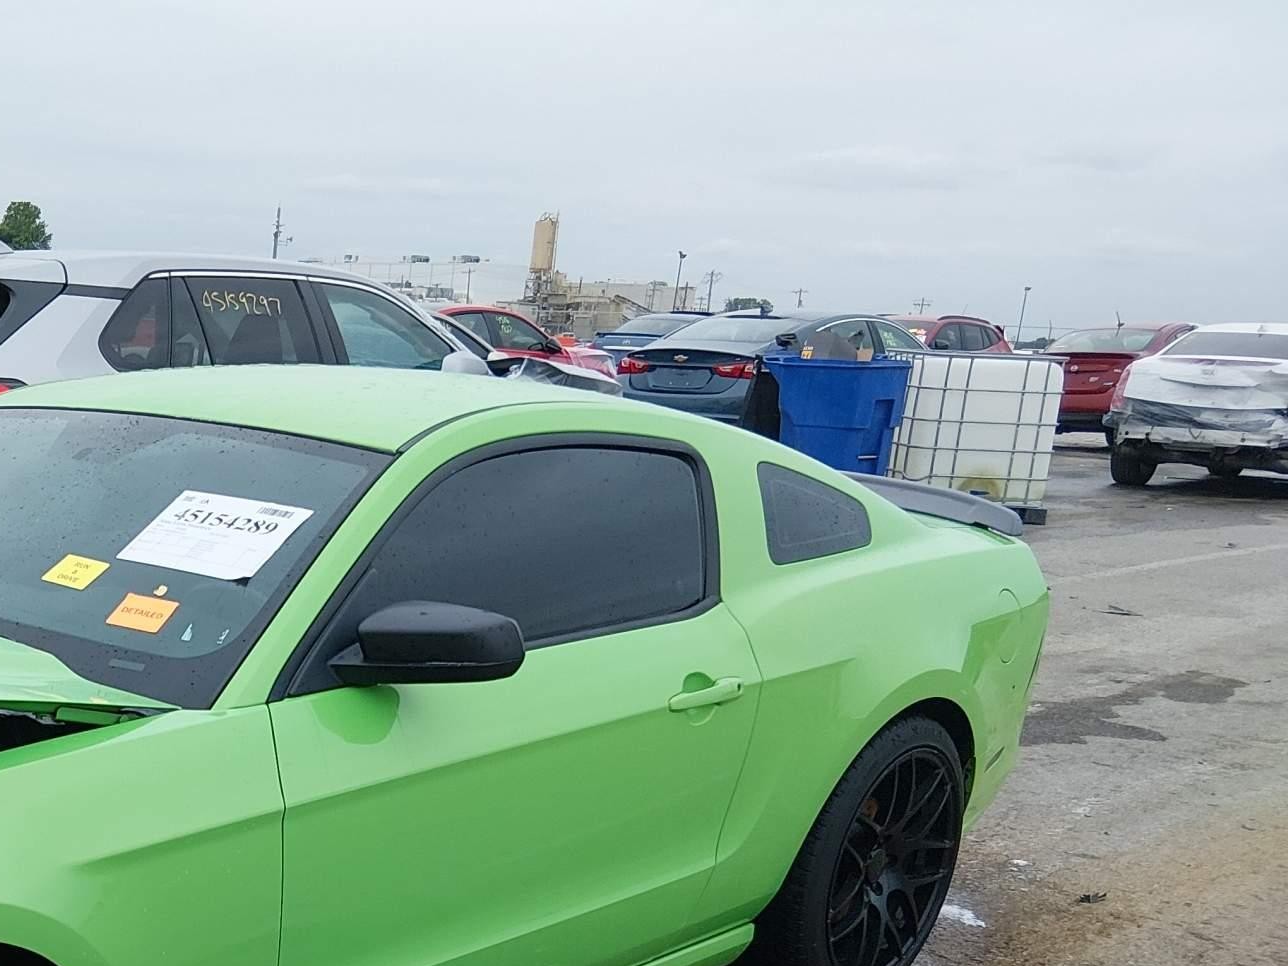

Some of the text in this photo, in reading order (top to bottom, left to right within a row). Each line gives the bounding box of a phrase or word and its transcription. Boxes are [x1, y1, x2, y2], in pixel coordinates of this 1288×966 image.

[203, 290, 281, 316] 45159297
[174, 508, 279, 535] 45154289
[120, 606, 164, 620] DETAILED
